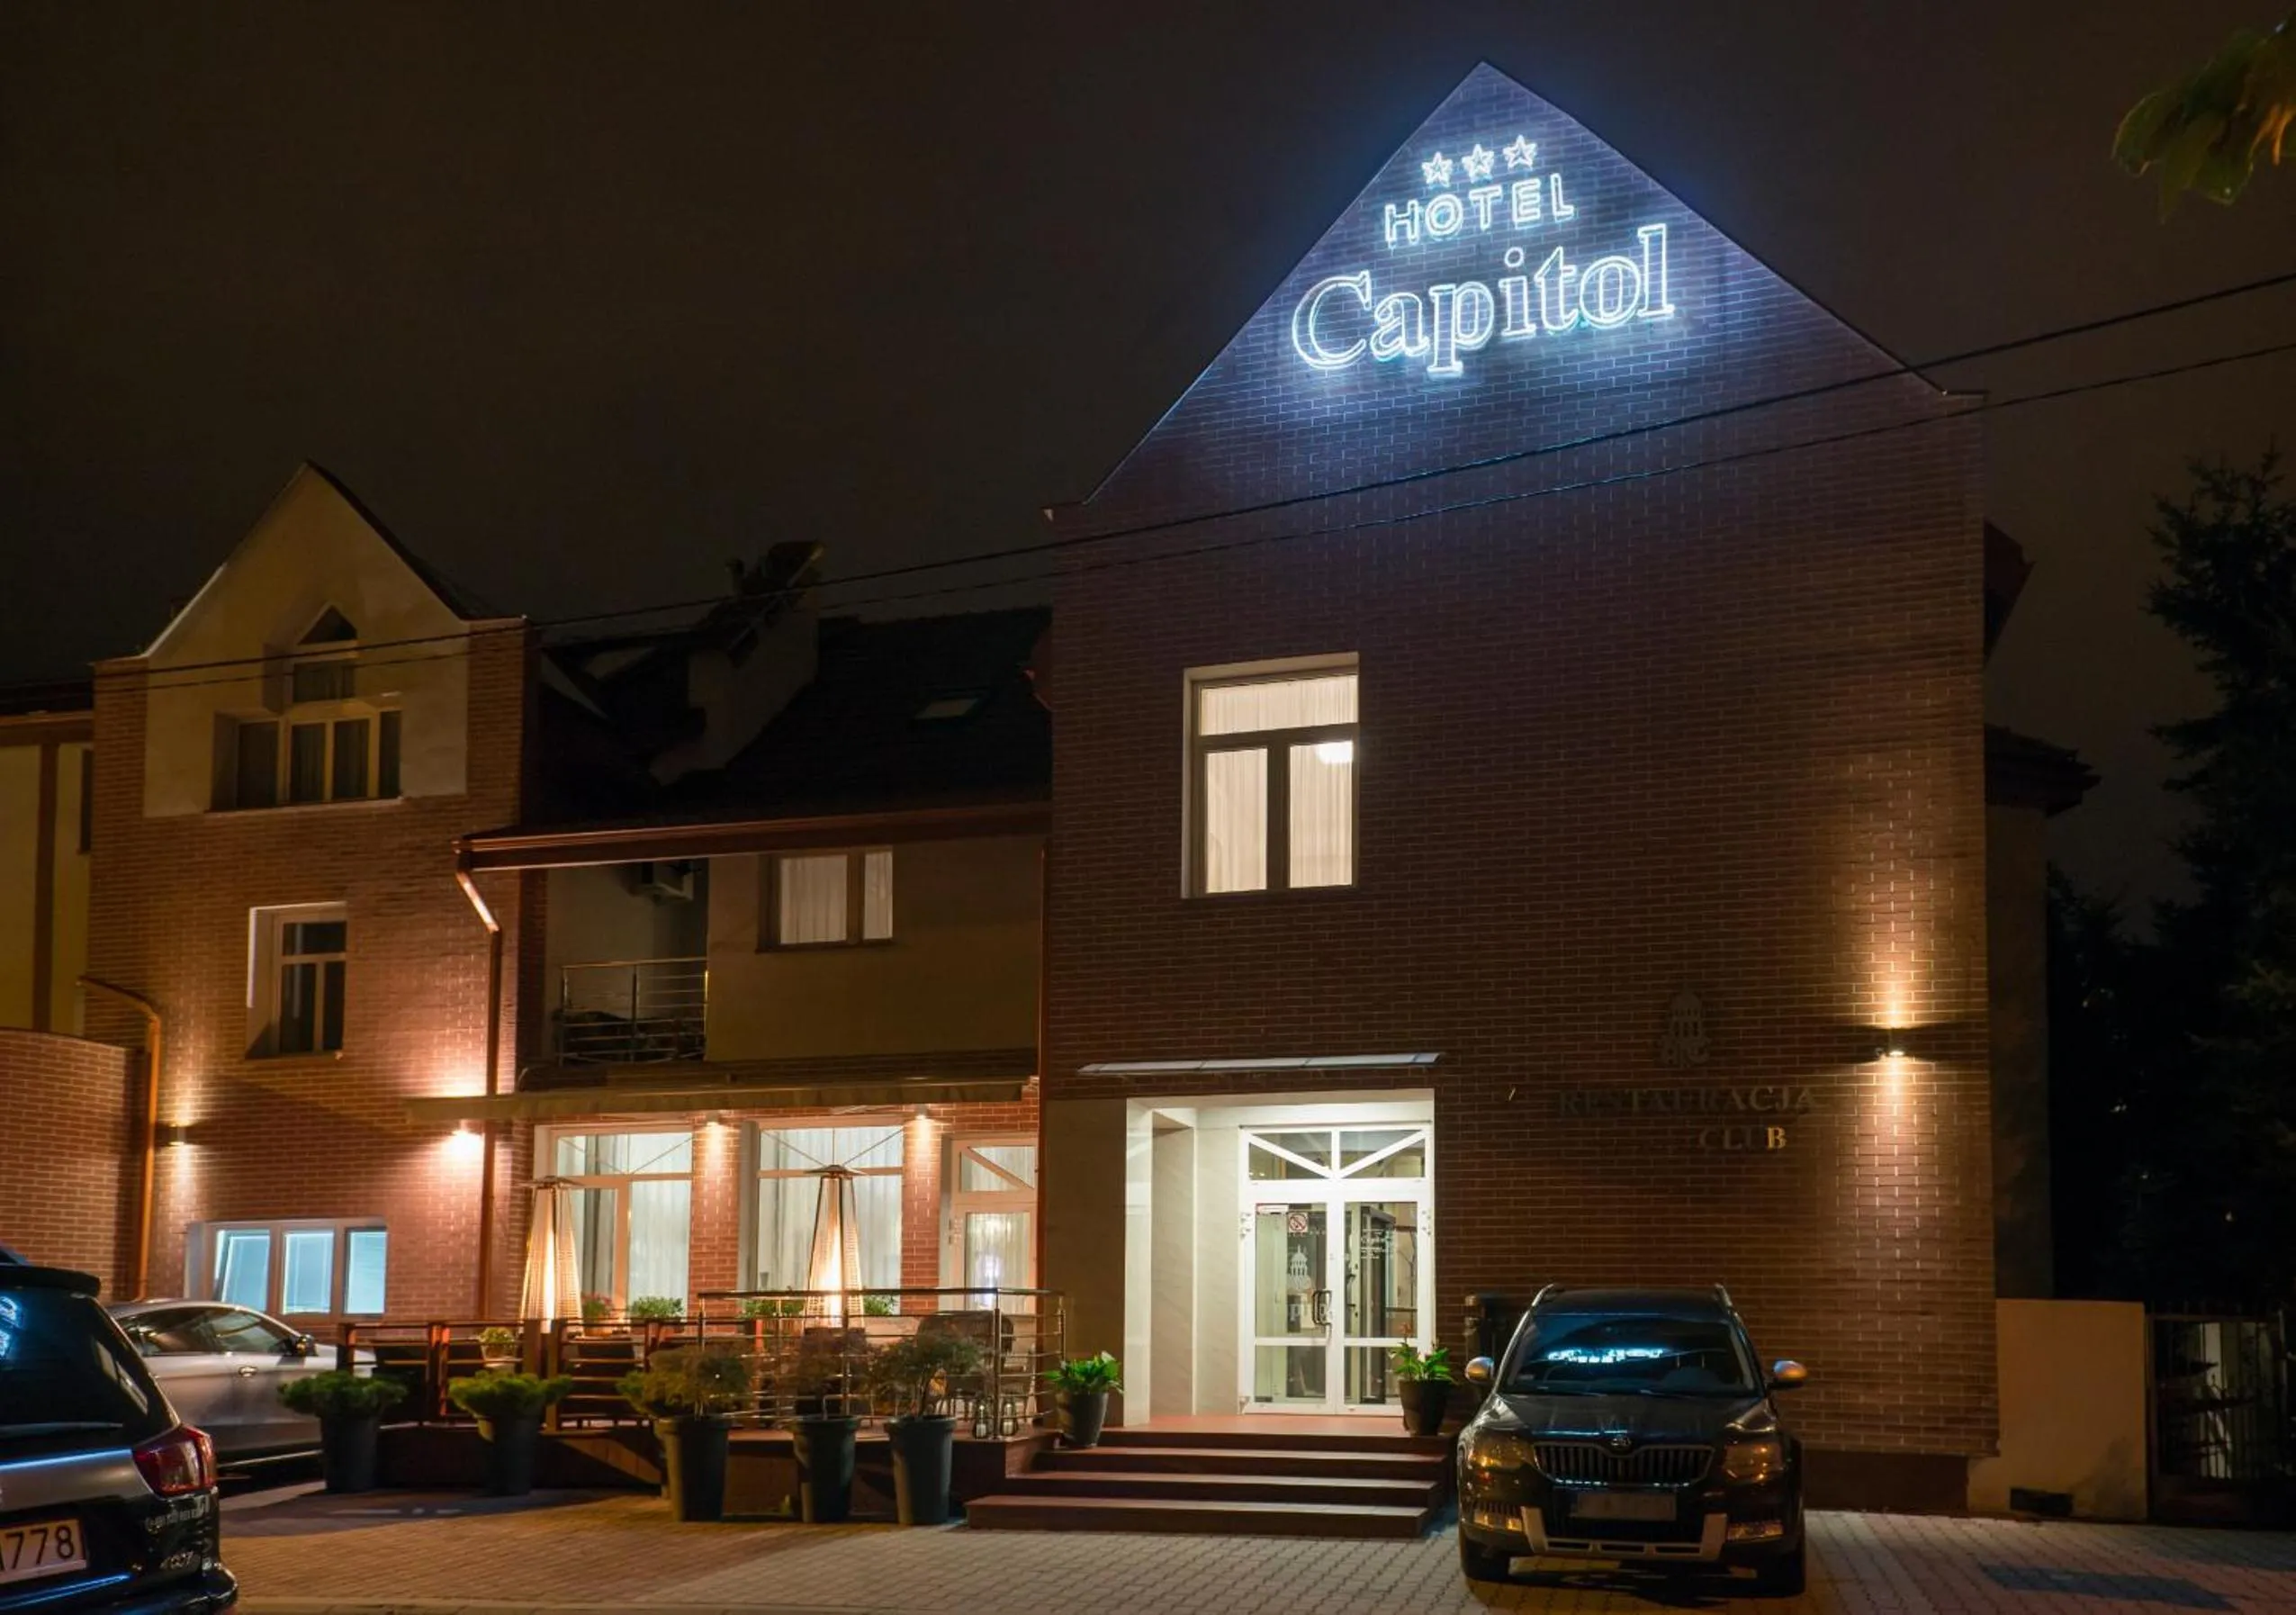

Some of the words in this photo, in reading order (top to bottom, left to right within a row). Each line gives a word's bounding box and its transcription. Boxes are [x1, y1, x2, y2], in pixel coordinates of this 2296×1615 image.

[1384, 172, 1575, 248] HOTEL
[1292, 223, 1675, 378] Capitol
[0, 1525, 74, 1570] 778
